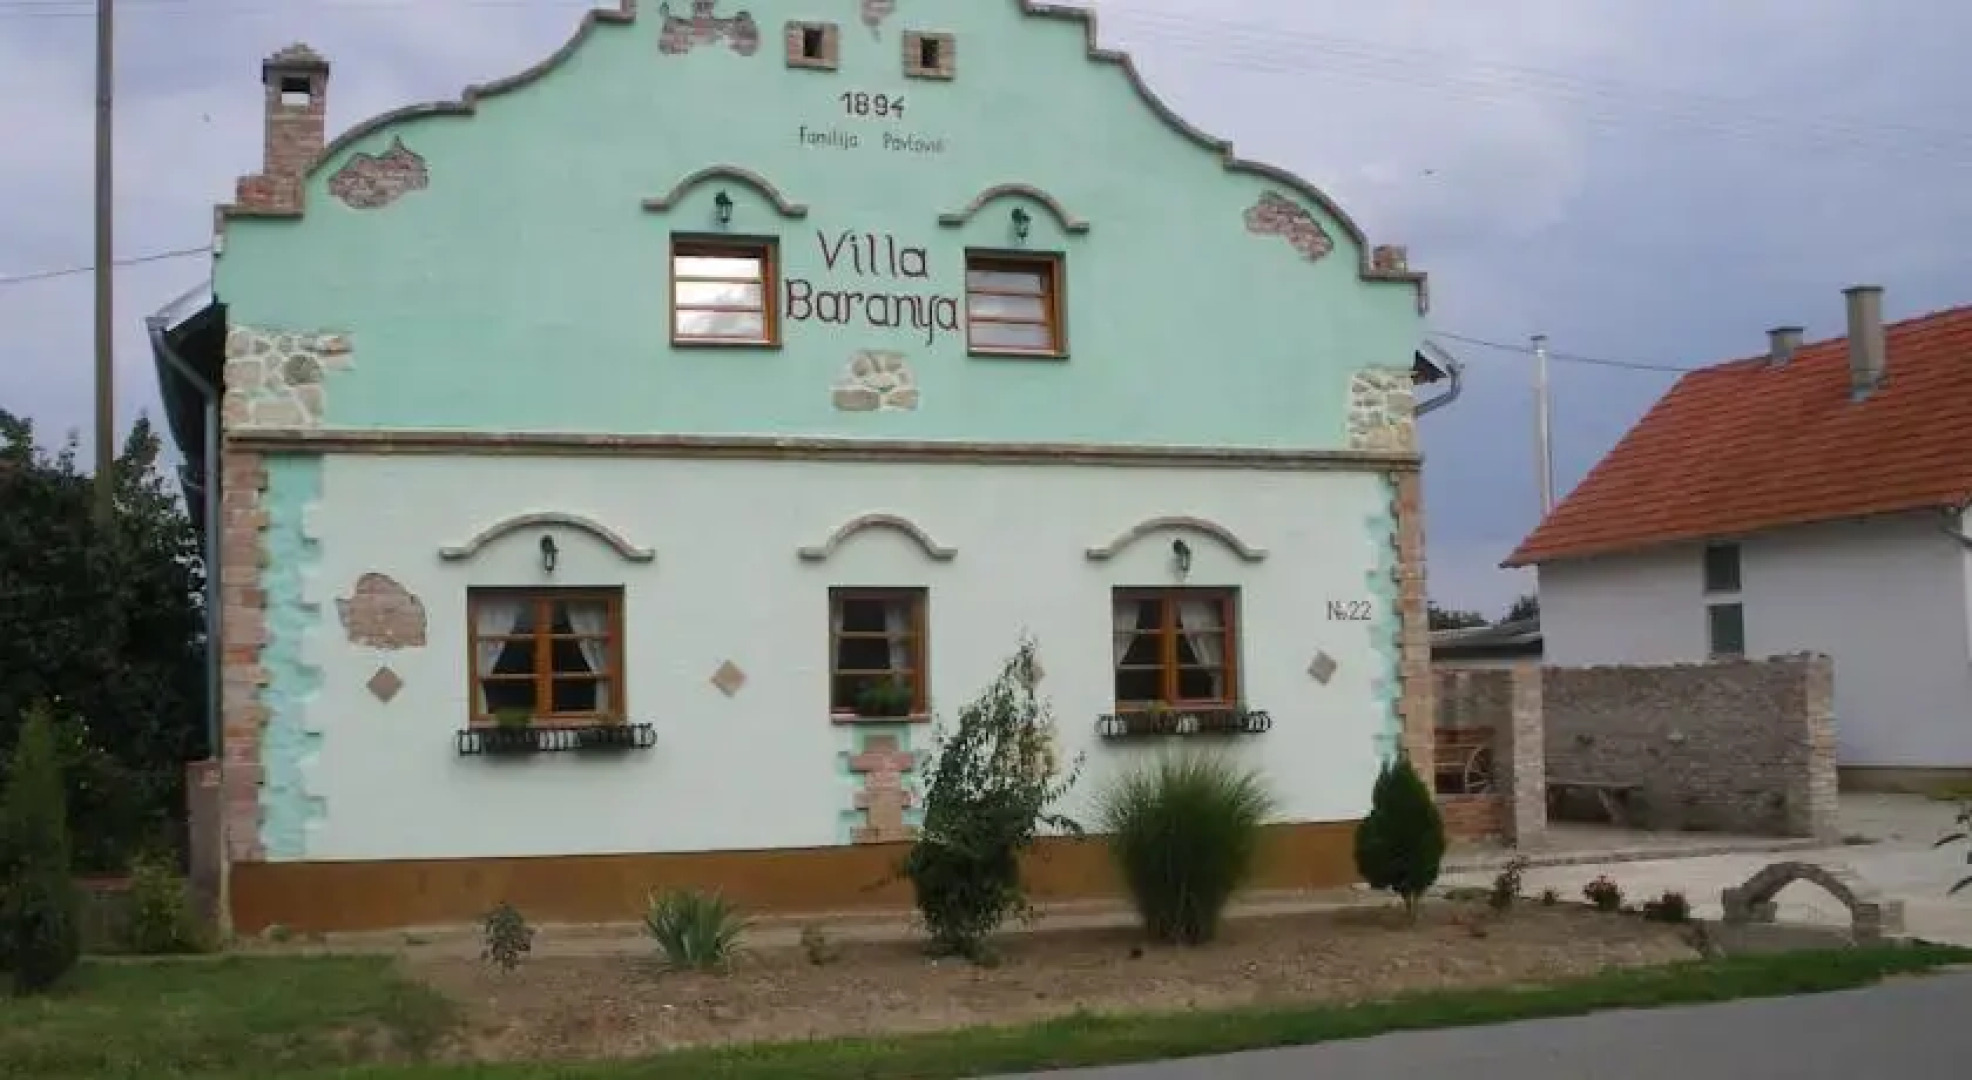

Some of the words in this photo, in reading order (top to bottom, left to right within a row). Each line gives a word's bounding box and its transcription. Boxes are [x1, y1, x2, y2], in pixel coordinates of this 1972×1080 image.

[839, 92, 905, 119] 1894
[816, 229, 928, 278] Villa
[785, 278, 959, 346] Baranya
